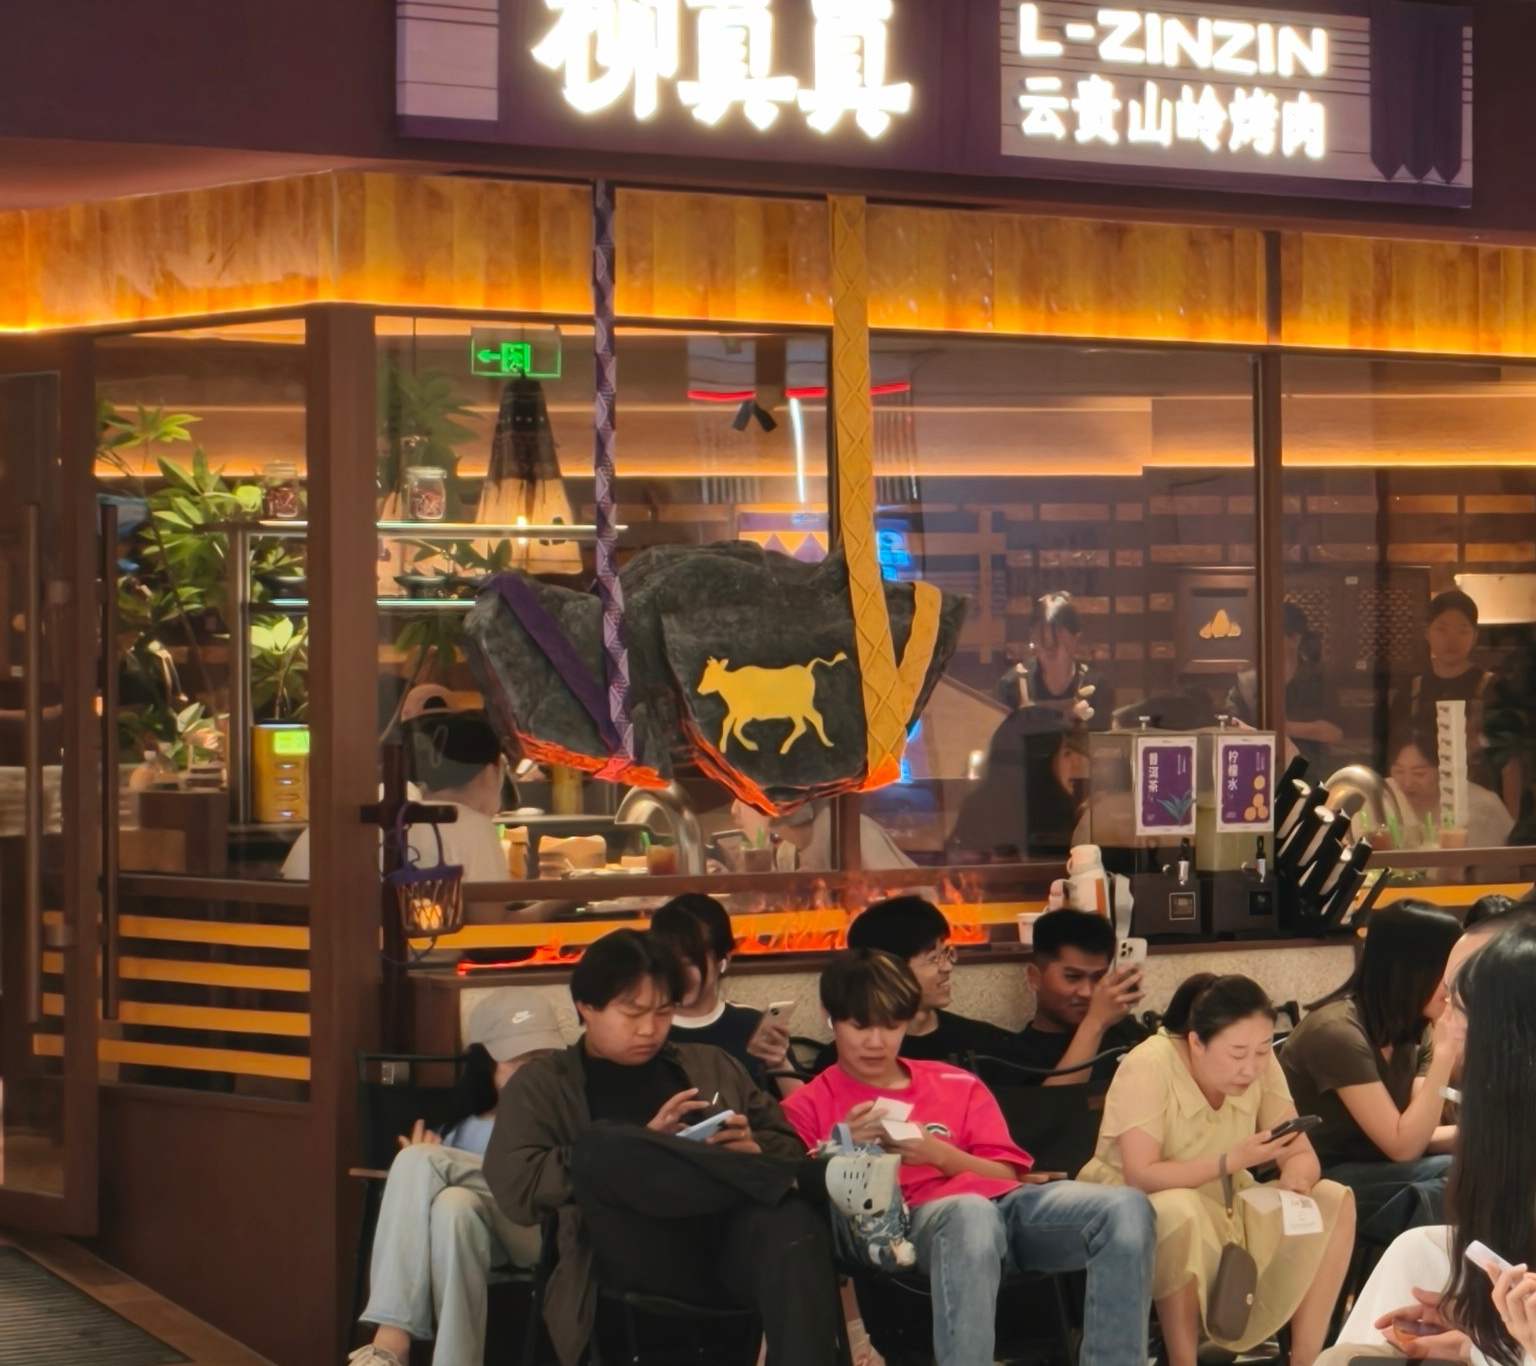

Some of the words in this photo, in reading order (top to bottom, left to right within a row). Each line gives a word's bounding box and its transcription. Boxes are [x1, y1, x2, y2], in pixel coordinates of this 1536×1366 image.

[1019, 2, 1328, 77] L-ZINZIN
[1019, 74, 1326, 159] 云贵山岭烤肉
